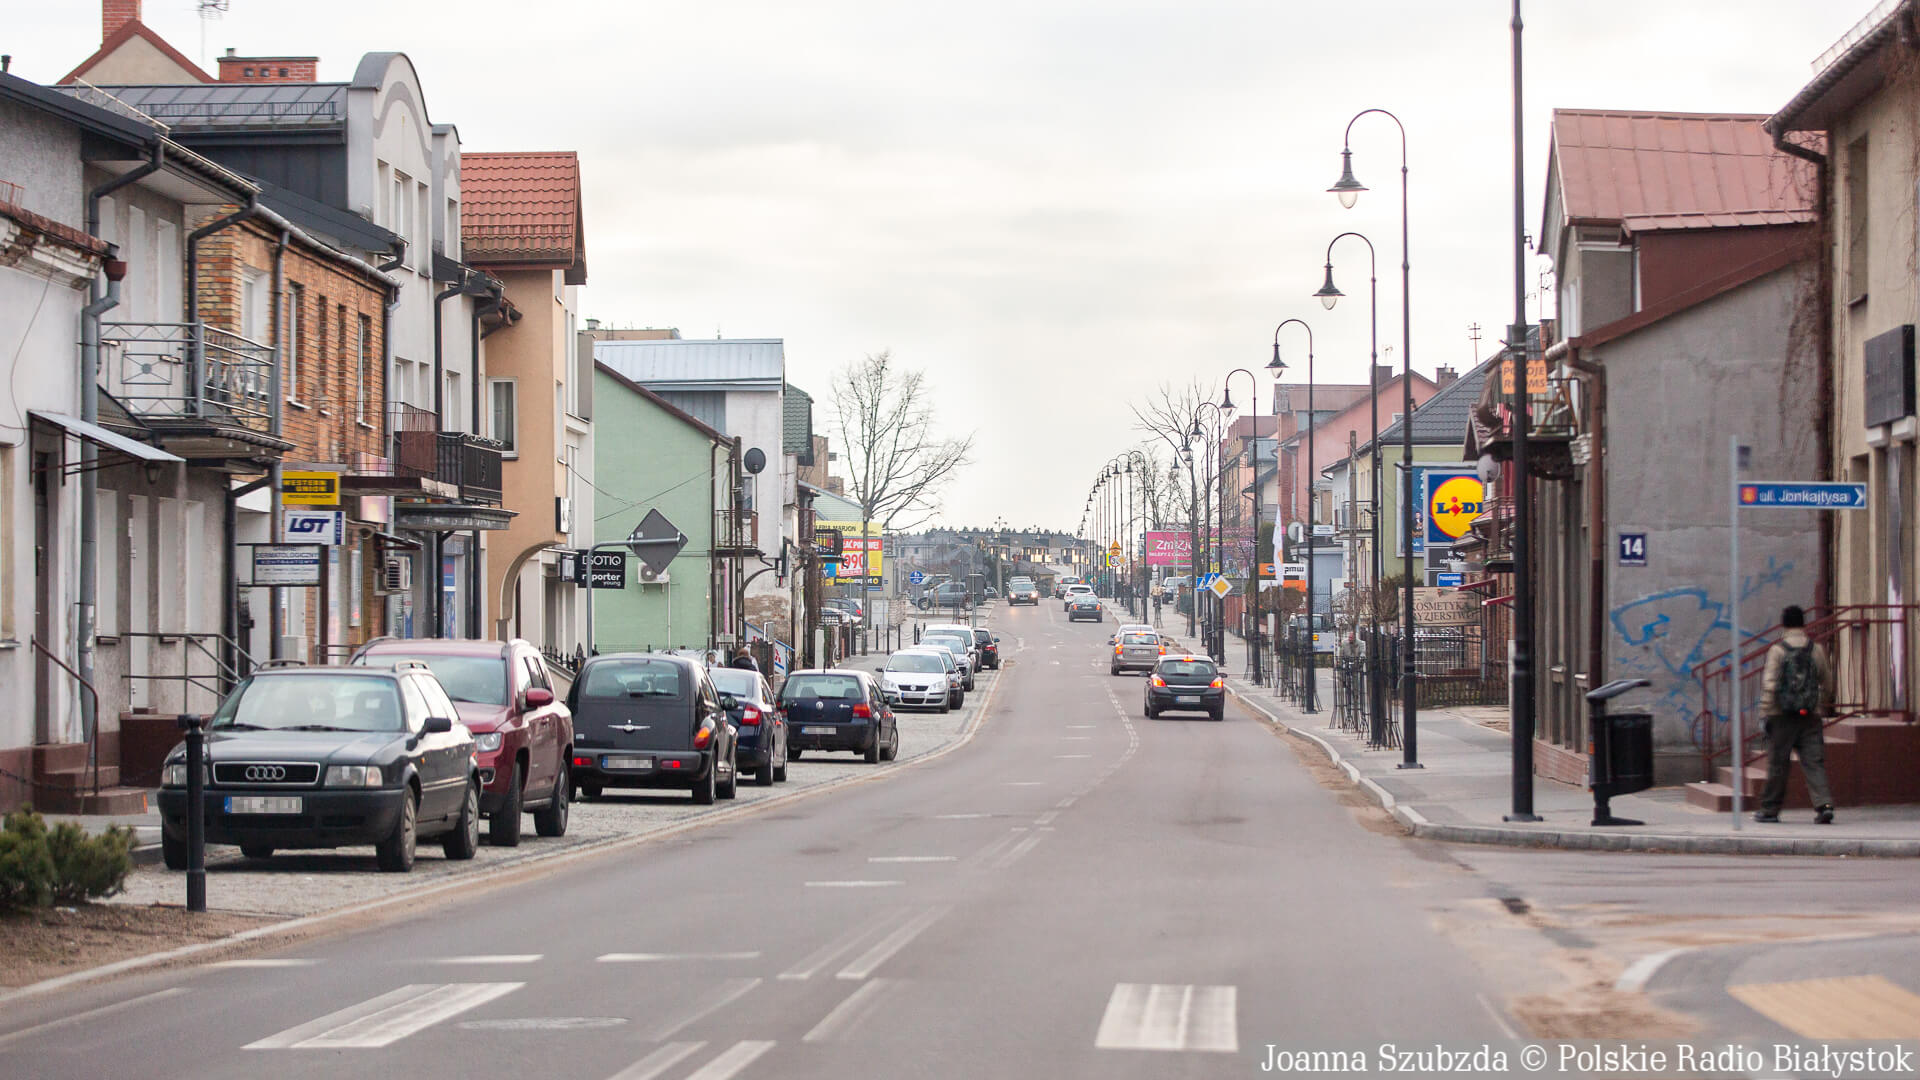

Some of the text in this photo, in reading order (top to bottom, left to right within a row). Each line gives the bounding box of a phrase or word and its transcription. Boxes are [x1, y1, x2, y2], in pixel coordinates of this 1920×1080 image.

[288, 518, 331, 533] LOT
[1621, 538, 1643, 555] 14
[582, 572, 621, 582] rporter
